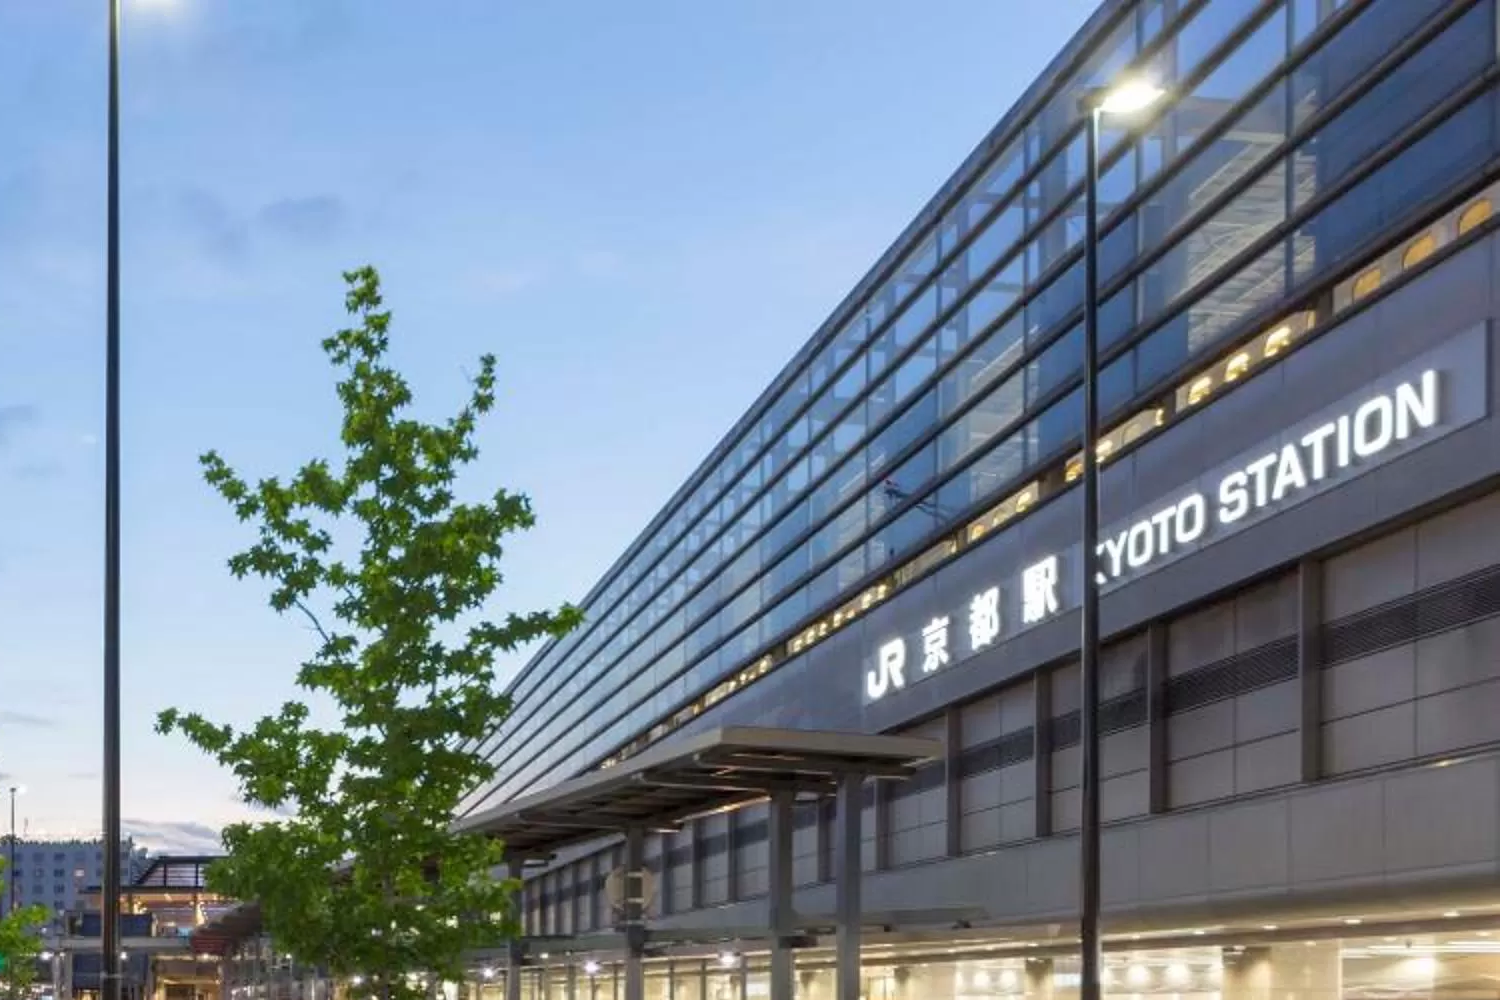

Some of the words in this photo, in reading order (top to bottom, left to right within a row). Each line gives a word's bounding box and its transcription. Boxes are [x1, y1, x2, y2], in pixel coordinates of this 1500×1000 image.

[867, 636, 907, 699] JR
[921, 554, 1060, 673] 京都駅
[1218, 369, 1438, 524] STATION
